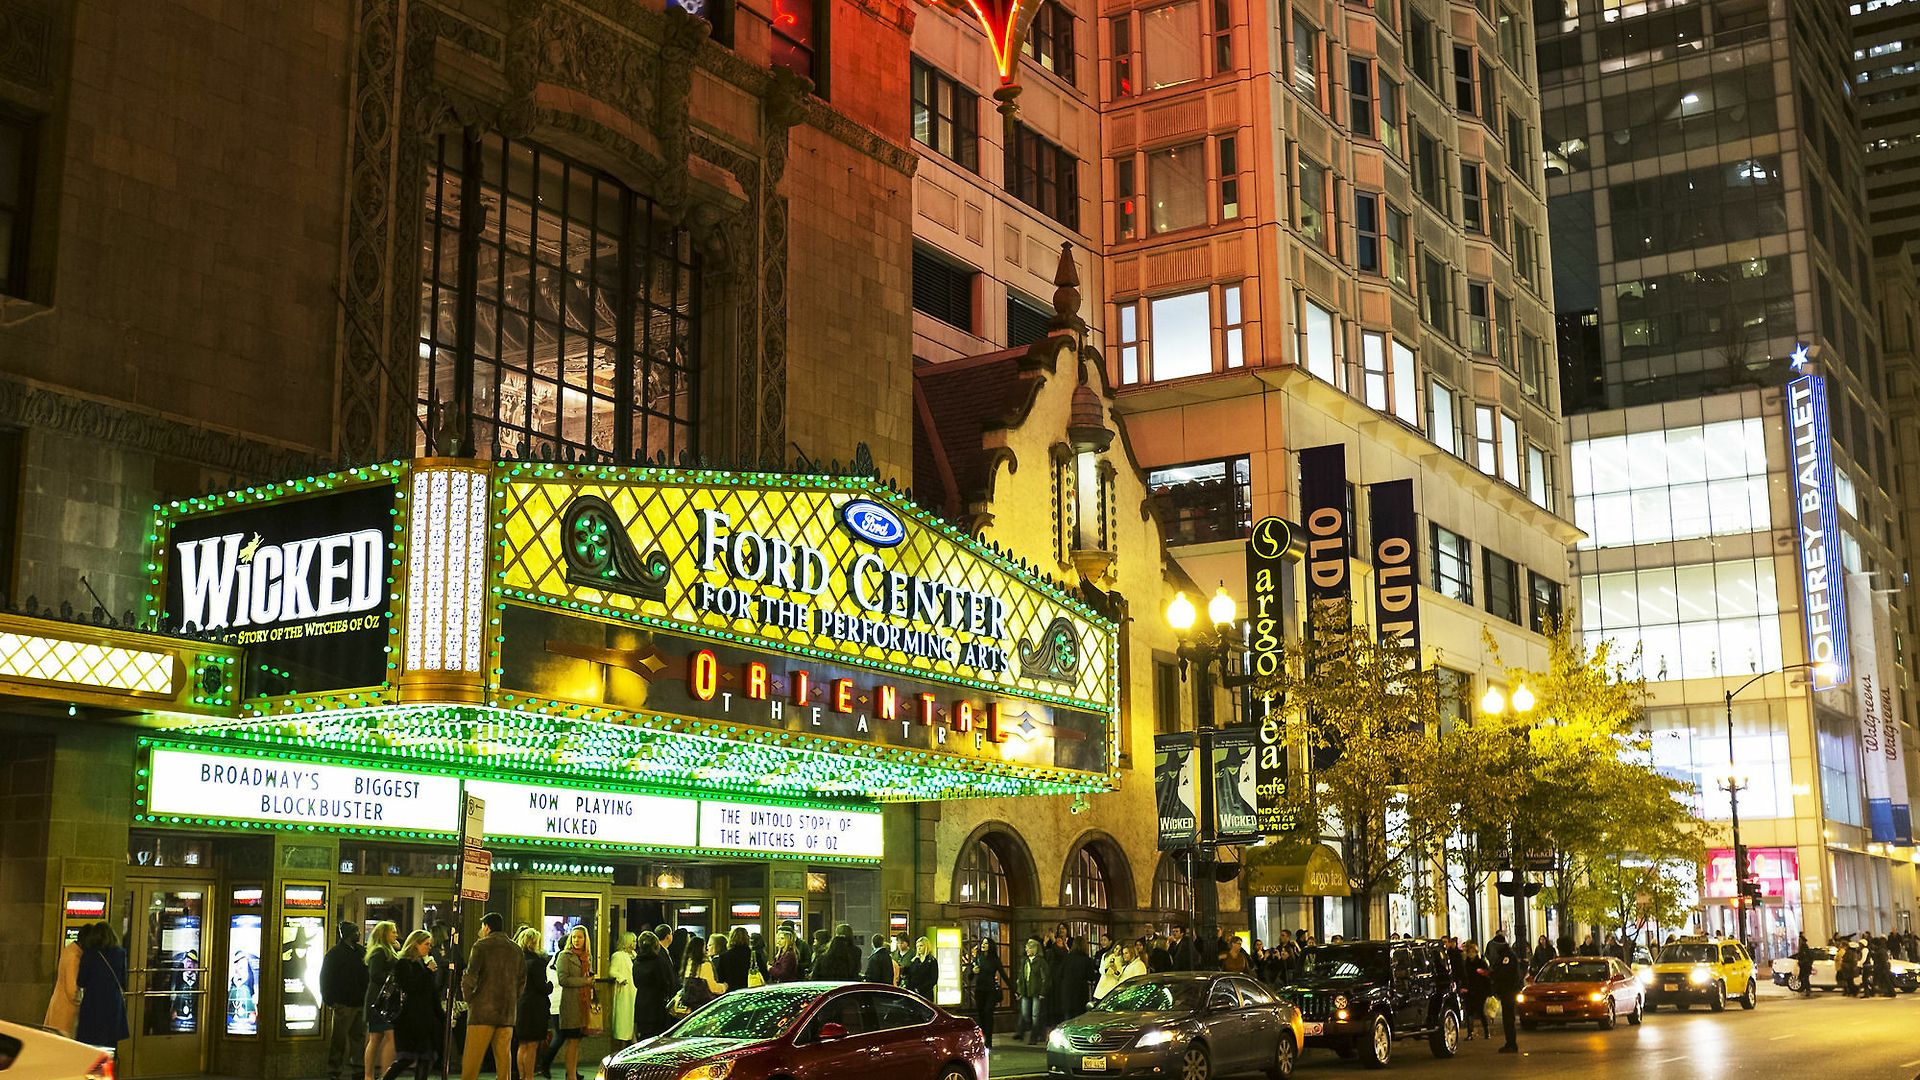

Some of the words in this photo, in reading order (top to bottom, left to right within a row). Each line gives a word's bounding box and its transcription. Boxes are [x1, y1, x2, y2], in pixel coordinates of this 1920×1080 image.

[1791, 385, 1821, 513] BALLET
[861, 512, 888, 536] Ford
[1308, 507, 1344, 587] OLD
[701, 508, 830, 596] FORD
[853, 554, 1009, 640] CENTER
[1378, 537, 1412, 612] OLD
[1803, 524, 1835, 676] OFFREY
[238, 628, 270, 645] STORY
[271, 628, 284, 642] OF
[284, 624, 303, 640] THE
[305, 619, 348, 637] WITCHES
[350, 618, 363, 631] OF
[364, 615, 380, 630] OZ
[702, 582, 752, 619] FOR
[761, 594, 810, 632] THE
[822, 610, 957, 662] PERFORMING
[964, 644, 1009, 673] ARTS
[1254, 568, 1278, 676] argo
[691, 650, 1009, 743] ORIENTAL
[722, 692, 983, 750] THEATRE
[1862, 674, 1881, 753] Walgreens
[1881, 687, 1899, 761] Walgreens
[201, 763, 319, 790] BROADWAY'S
[355, 777, 420, 799] BIGGEST
[261, 795, 383, 820] BLOCKBUSTER
[529, 793, 559, 812] NOW
[576, 797, 633, 816] PLAYING
[1256, 777, 1286, 796] café
[546, 816, 597, 835] WICKED
[720, 829, 741, 845] THE
[749, 831, 795, 848] WITCHES
[806, 835, 818, 850] OF
[825, 836, 838, 850] OZ
[721, 808, 741, 825] THE
[751, 810, 792, 828] UNTOLD
[799, 814, 832, 830] STORY
[839, 817, 851, 831] OF
[1311, 871, 1330, 891] argo
